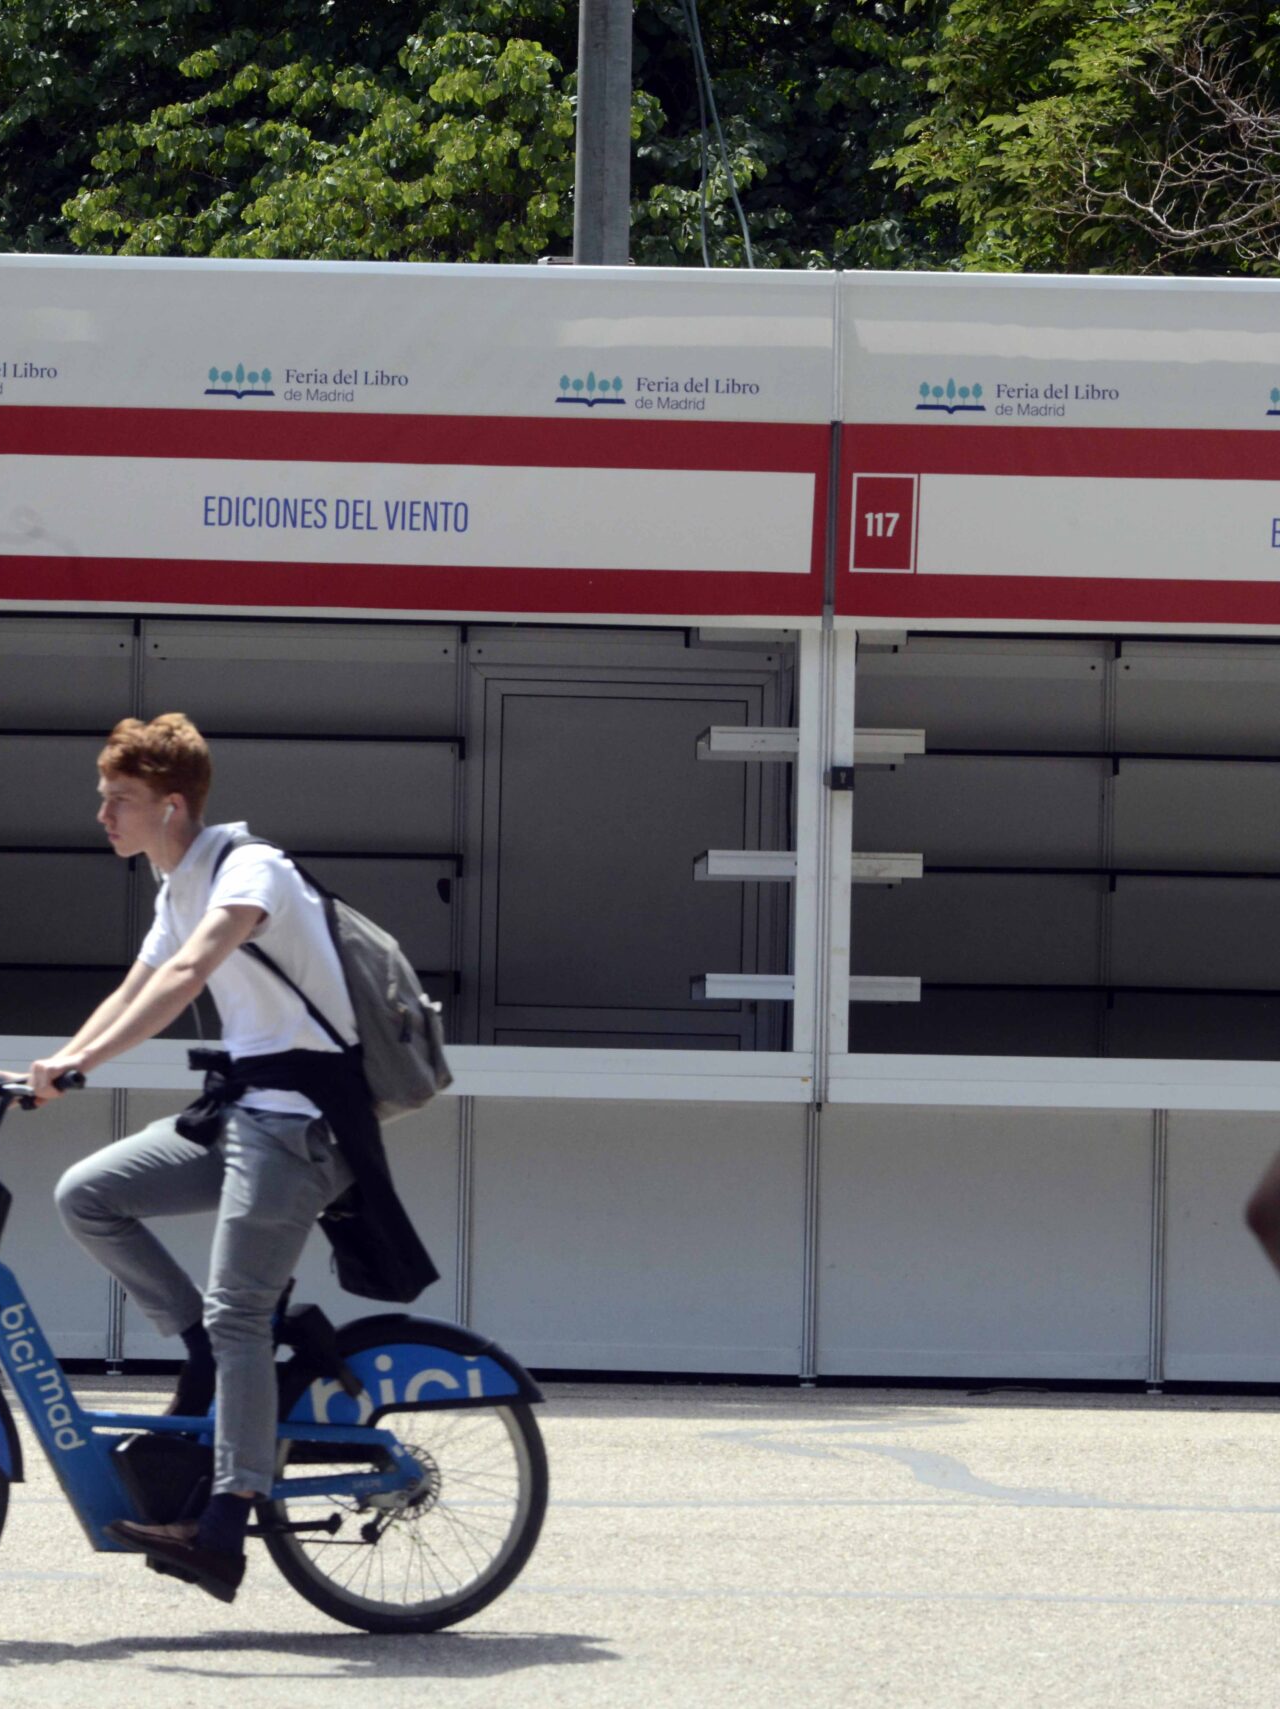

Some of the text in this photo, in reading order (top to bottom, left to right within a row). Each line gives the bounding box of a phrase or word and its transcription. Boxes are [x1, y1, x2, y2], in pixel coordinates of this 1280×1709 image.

[12, 362, 58, 379] Libro
[285, 368, 409, 387] Feria del Libro
[283, 387, 355, 402] de Madrid
[636, 376, 761, 395] Feria del Libro
[996, 383, 1120, 401] Feria del Libro
[634, 396, 706, 411] de Madrid
[994, 402, 1066, 417] de Madrid
[203, 495, 470, 533] EDICIONES DEL VIENTO
[864, 511, 901, 538] 117
